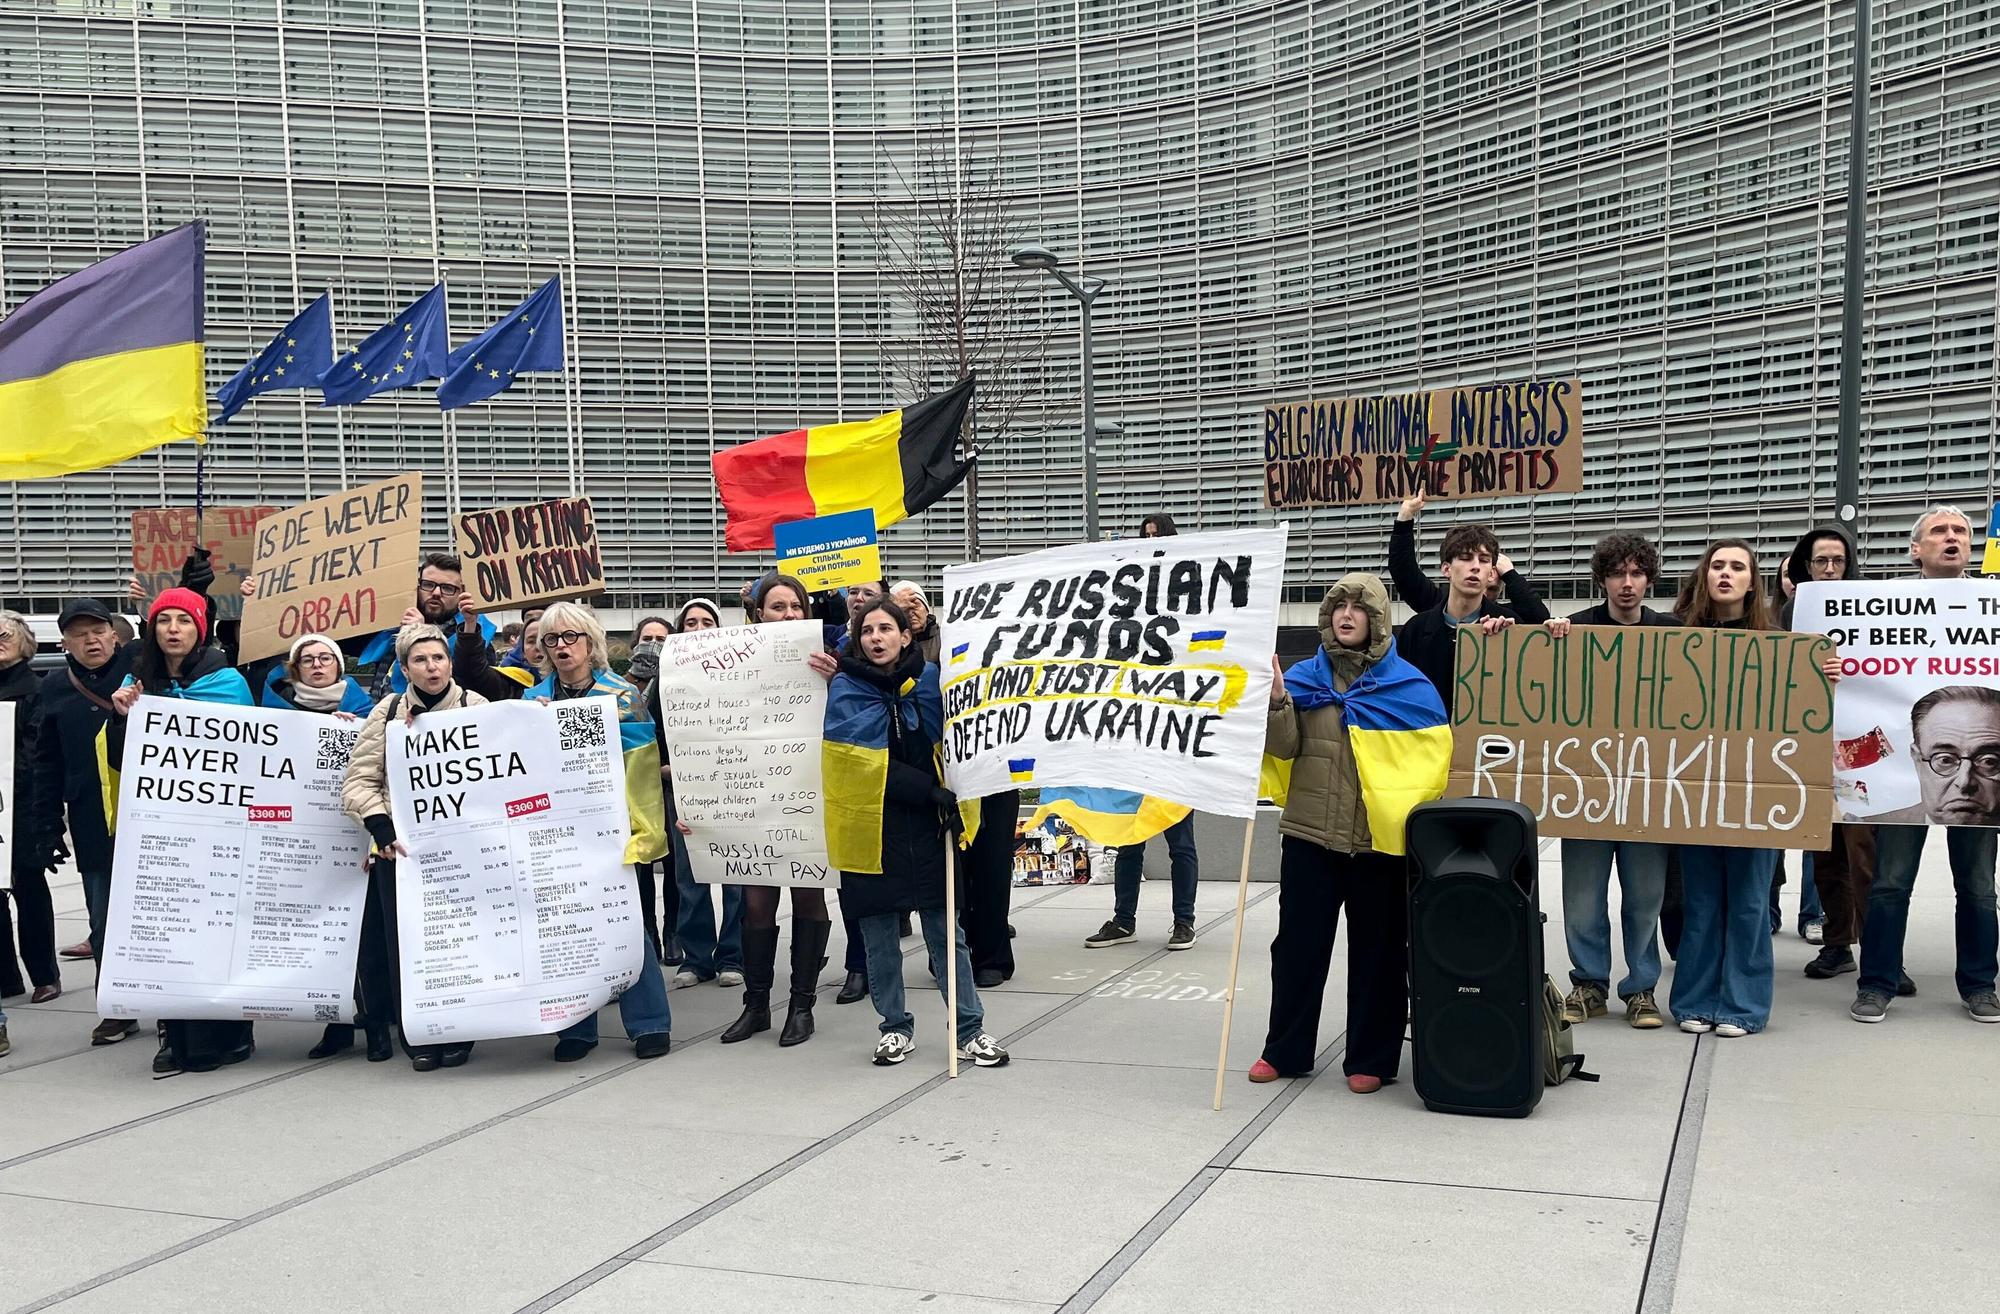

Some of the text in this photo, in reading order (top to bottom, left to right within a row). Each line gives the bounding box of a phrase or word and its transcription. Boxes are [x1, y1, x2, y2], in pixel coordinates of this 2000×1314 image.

[1266, 380, 1571, 462] BELGIAN NATIONAL INTERESTS
[1376, 455, 1454, 500] PRIVATE
[1458, 449, 1559, 493] PROFITS
[132, 510, 198, 544] FACE
[257, 483, 409, 560] IS DE WEVER
[461, 498, 594, 558] STOP BETTING
[786, 548, 796, 556] МИ
[798, 544, 825, 555] БУДЕМО
[831, 536, 867, 549] УКРАЇНОЮ
[133, 541, 226, 571] CAUE
[812, 553, 843, 563] СТІЛЬКИ,
[797, 558, 860, 575] СКІЛЬКИ ПОТРІБНО
[257, 558, 302, 599] THE
[477, 559, 512, 602] ON
[947, 581, 1015, 624] USE
[1825, 598, 1936, 616] BELGIUM
[981, 615, 1180, 668] FUNDS
[1827, 628, 1859, 646] OF
[1870, 628, 1936, 648] BEER,
[1841, 658, 1918, 676] OODY
[988, 666, 1033, 700] AND
[1034, 663, 1120, 697] JUST
[1124, 670, 1220, 702] WAY
[1454, 628, 1624, 728] BELGIUM
[667, 695, 812, 712] Destroyed houses 140 000
[668, 712, 794, 727] Children killed or 2 700
[145, 712, 279, 746] FAISONS
[717, 724, 748, 734] injured
[953, 703, 1031, 763] DEFEND
[1045, 699, 1223, 758] UKRAINE
[405, 724, 480, 759] MAKE
[674, 745, 711, 757] Civilians
[764, 745, 776, 754] 20
[783, 743, 806, 753] 000
[140, 744, 295, 779] PAYER LA
[716, 756, 748, 765] detained
[409, 751, 527, 791] RUSSIA
[677, 771, 705, 782] Victims
[768, 766, 792, 776] 500
[136, 776, 255, 807] RUSSIE
[680, 795, 719, 808] Kidnapped
[723, 795, 757, 804] children
[788, 791, 816, 800] 500
[249, 809, 291, 819] $300 MD
[413, 792, 466, 823] PAY
[507, 799, 549, 815] $300 MD
[684, 810, 755, 822] Lives destroyed
[529, 828, 563, 836] CULTURELE
[422, 873, 470, 885] INFRASTRUCTUUR
[726, 861, 828, 880] MUST PAY
[424, 896, 475, 907] INFRASTRUCTUUR
[537, 903, 582, 913] VERNIETIGING
[563, 906, 594, 915] KACHOVKA
[424, 911, 477, 922] LANDBOUWSECTOR
[539, 927, 592, 939] EXPLOSIEGEVAAR
[425, 979, 483, 990] GEZONDHEIDSZORG
